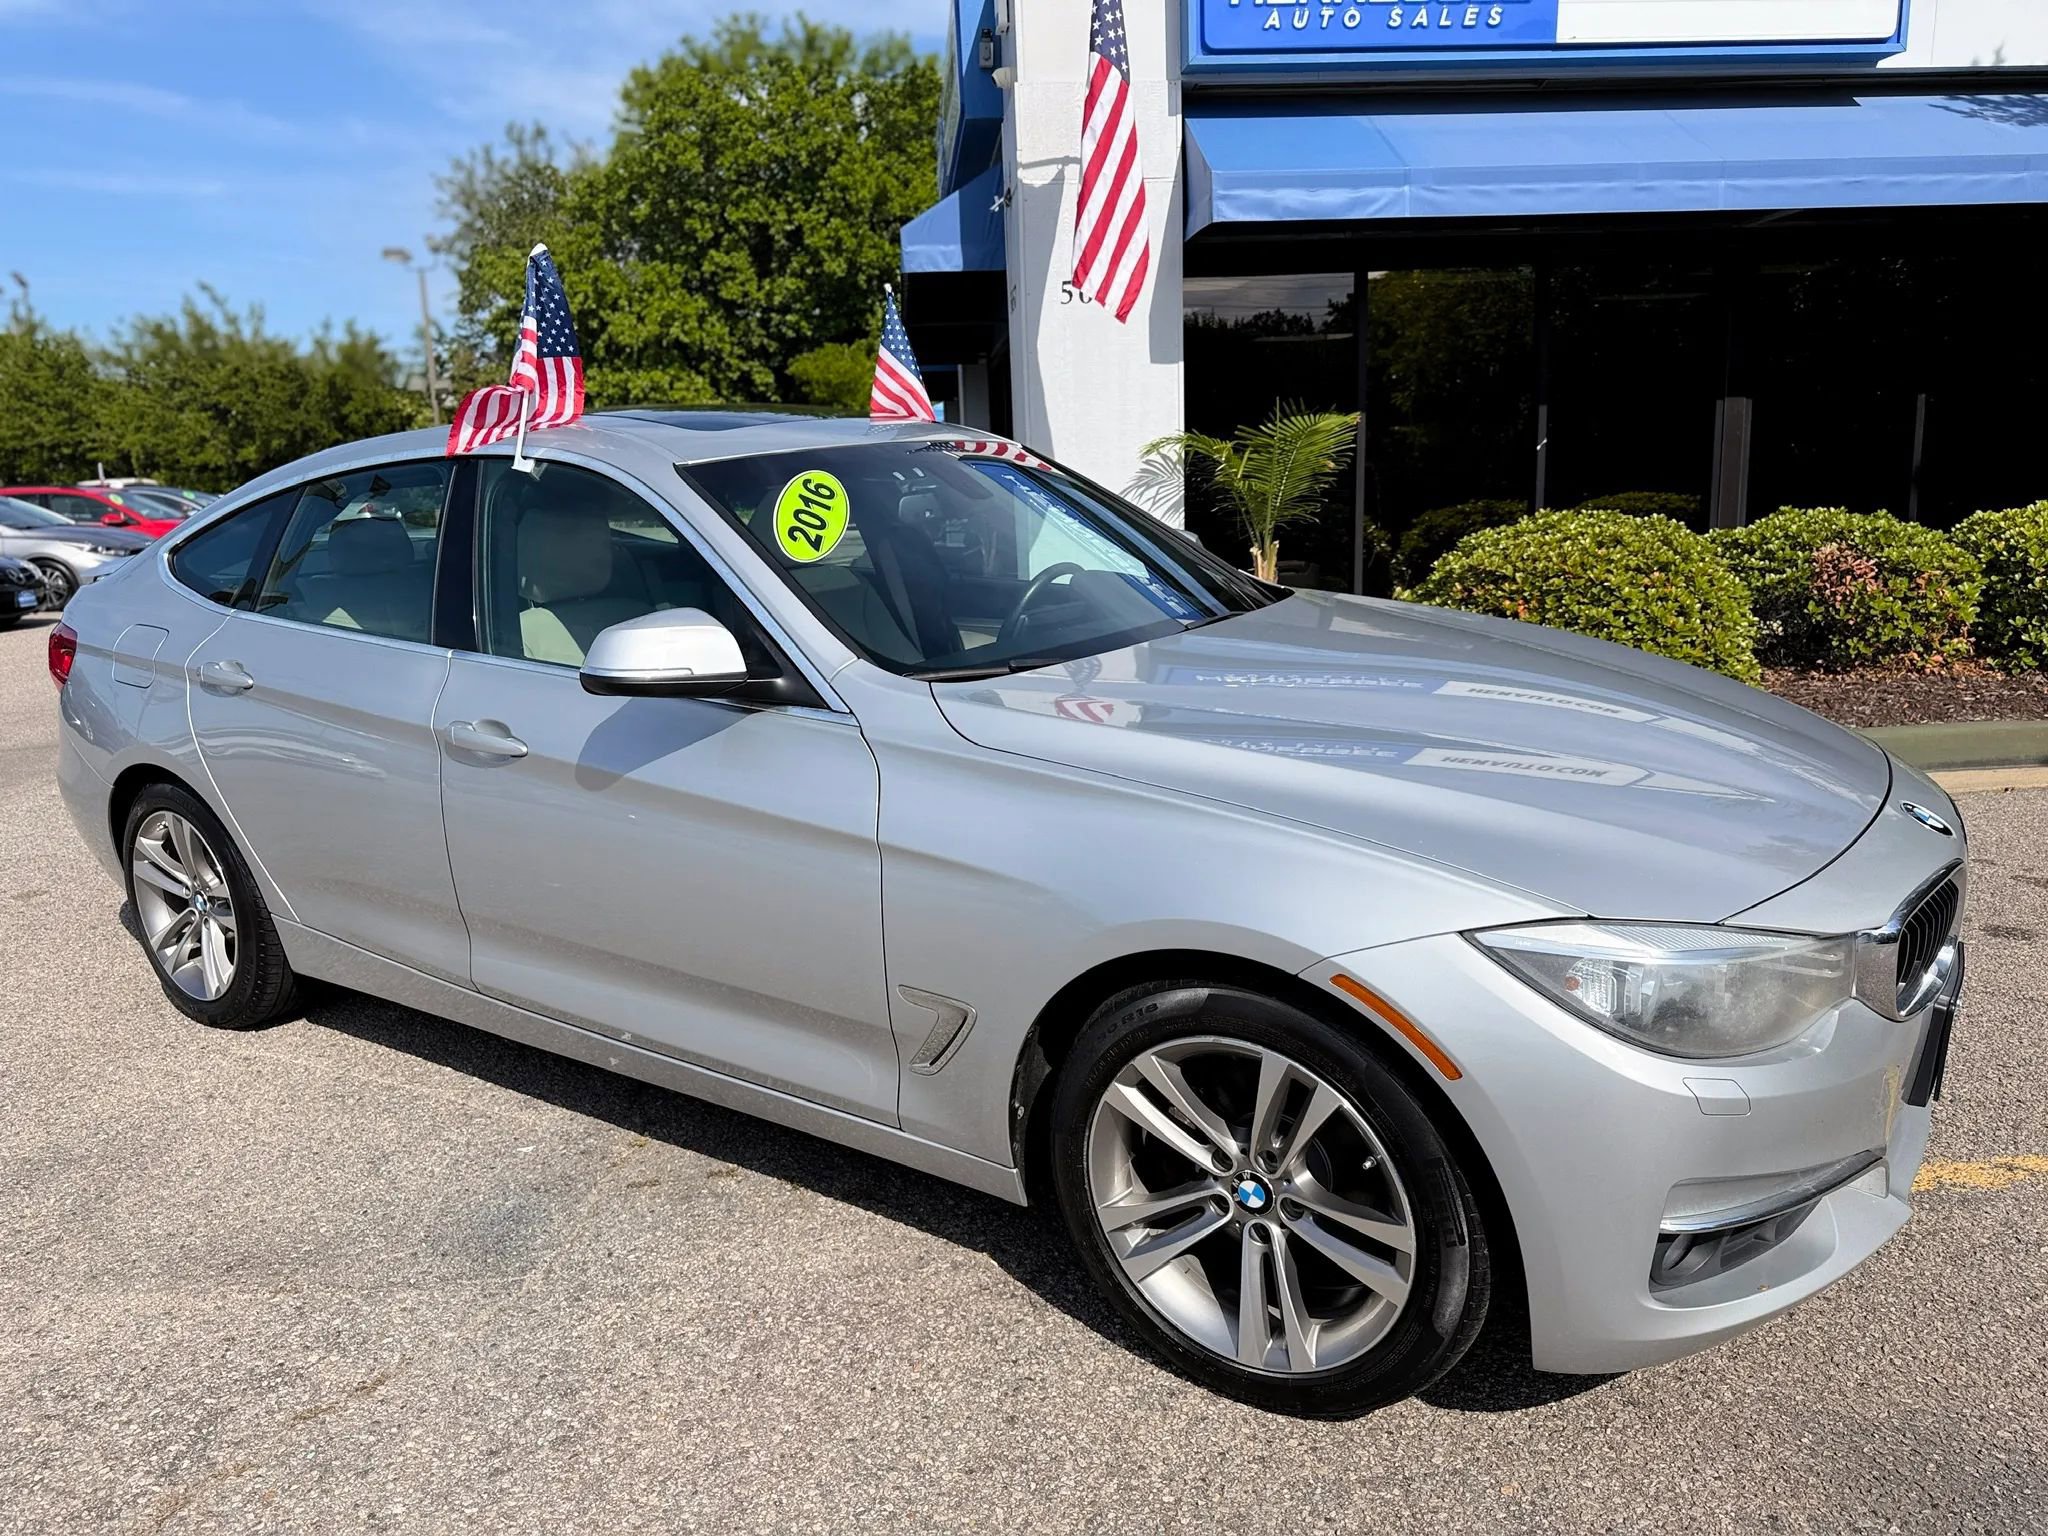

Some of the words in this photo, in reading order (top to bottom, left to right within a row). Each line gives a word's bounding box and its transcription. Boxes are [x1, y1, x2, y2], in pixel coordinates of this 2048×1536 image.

[1263, 6, 1363, 29] AUTO
[1387, 5, 1503, 28] SALES
[787, 478, 836, 553] 2016
